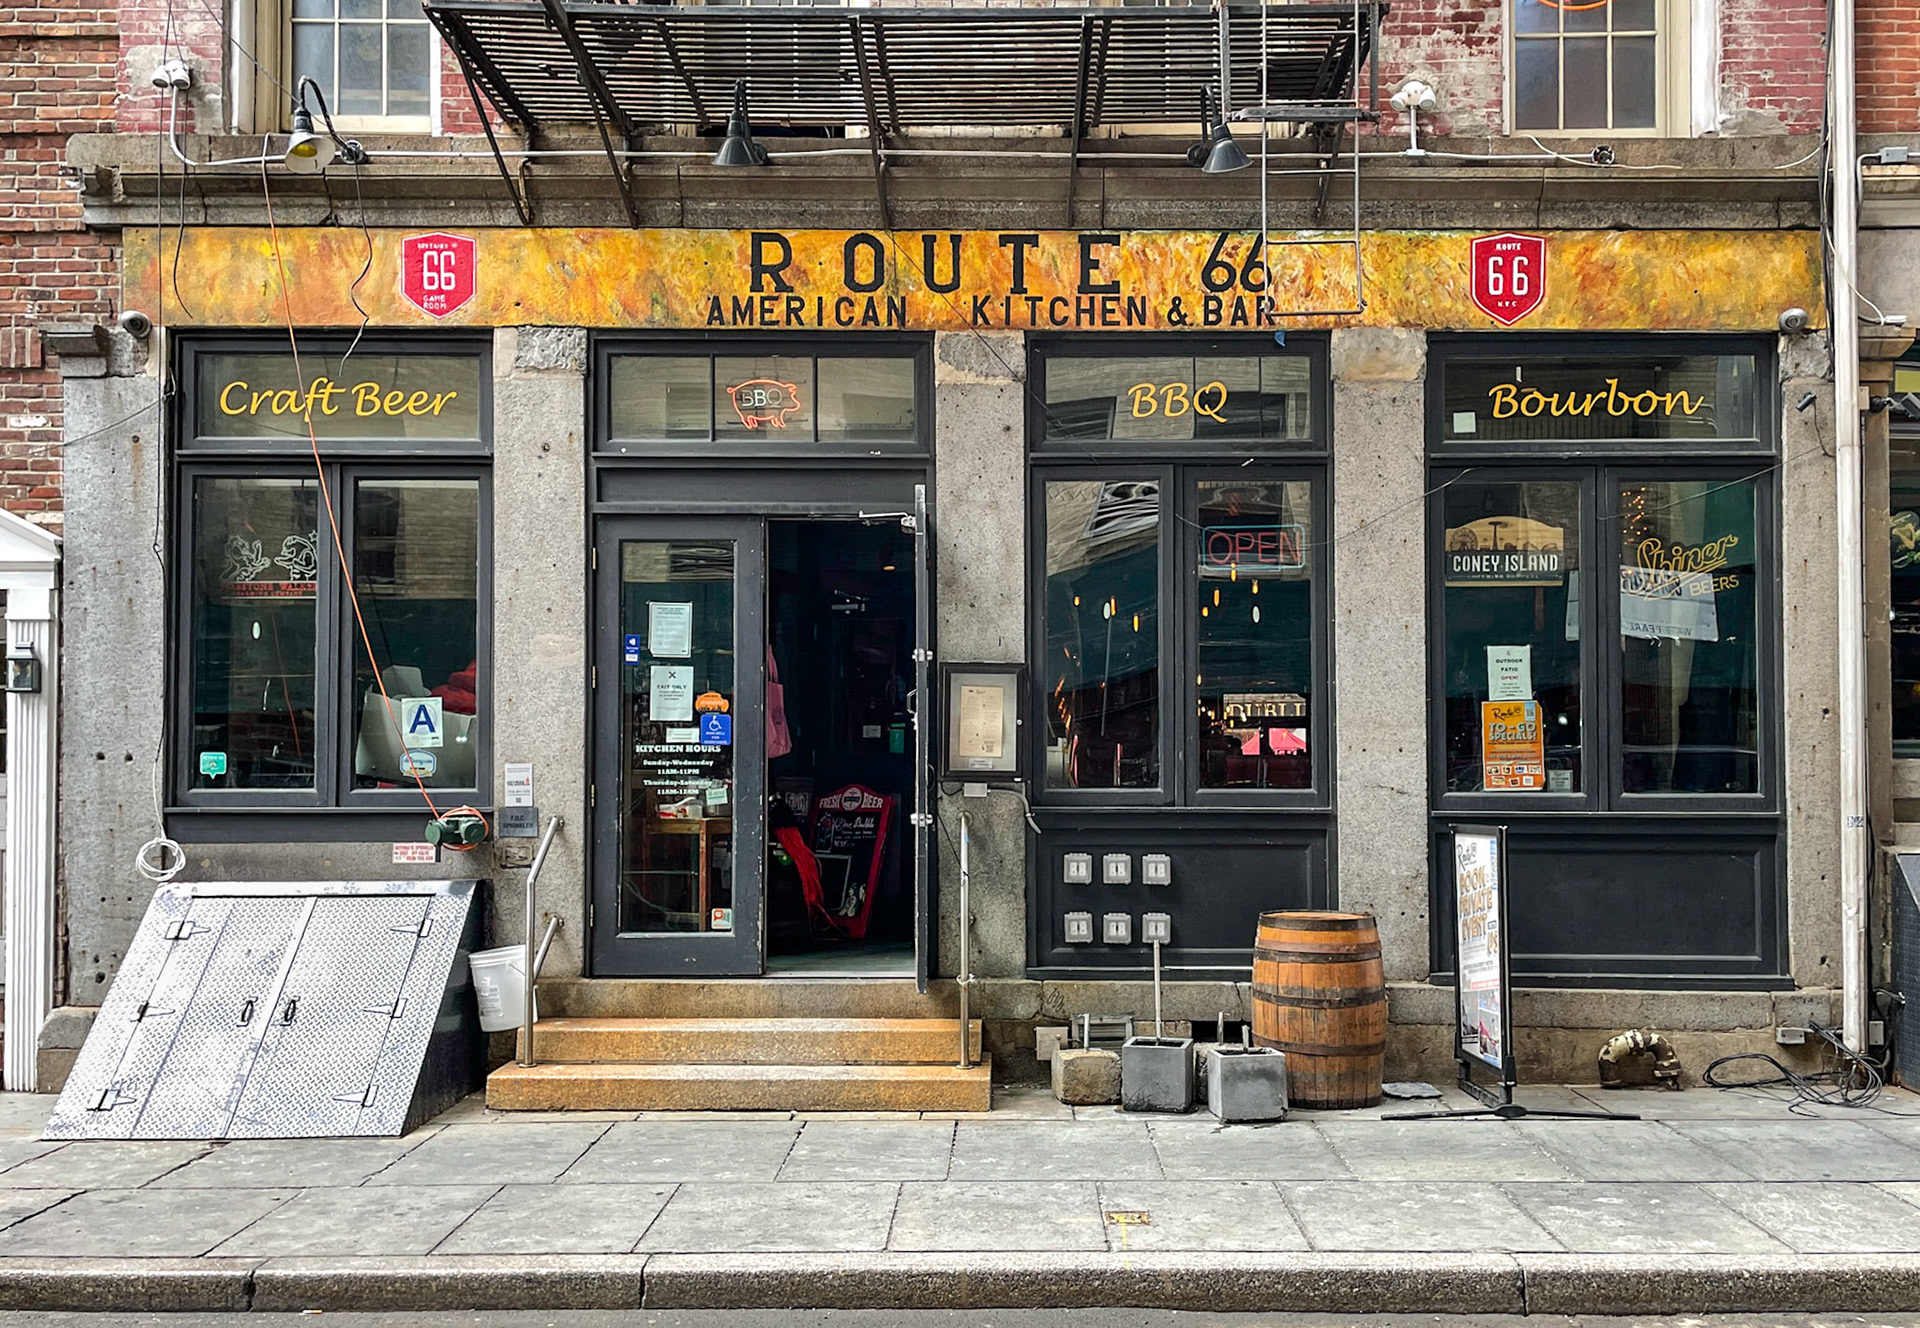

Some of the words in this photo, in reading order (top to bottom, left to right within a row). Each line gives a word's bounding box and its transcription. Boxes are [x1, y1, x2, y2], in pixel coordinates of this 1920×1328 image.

[1496, 242, 1521, 250] ROUTE
[423, 250, 456, 291] 66
[749, 231, 1121, 295] ROUTE
[1200, 232, 1273, 293] 66
[1488, 256, 1529, 296] 66
[423, 294, 446, 302] GAME
[423, 302, 447, 310] ROOM
[707, 295, 907, 327] AMERICAN
[971, 295, 1147, 326] KITCHEN
[1166, 295, 1188, 326] &
[1203, 295, 1277, 326] BAR
[219, 376, 347, 423] Craft
[351, 380, 458, 417] Beer
[741, 388, 783, 408] BBQ
[1127, 380, 1229, 424] BBQ
[1488, 378, 1704, 420] Bourbon
[1208, 531, 1301, 565] OPEN
[1453, 554, 1500, 572] CONEY
[1504, 554, 1559, 572] ISLAND
[1689, 574, 1740, 596] BEERS
[409, 704, 436, 734] A
[636, 744, 683, 752] KITCHEN
[685, 744, 721, 753] HOURS
[1489, 732, 1538, 741] SPECIALS!
[819, 794, 842, 809] FRESH
[861, 792, 884, 809] BEER
[1459, 865, 1486, 896] BOOK
[1459, 886, 1493, 919] PRIVATE
[1462, 913, 1488, 942] EVENT
[1487, 931, 1499, 956] US
